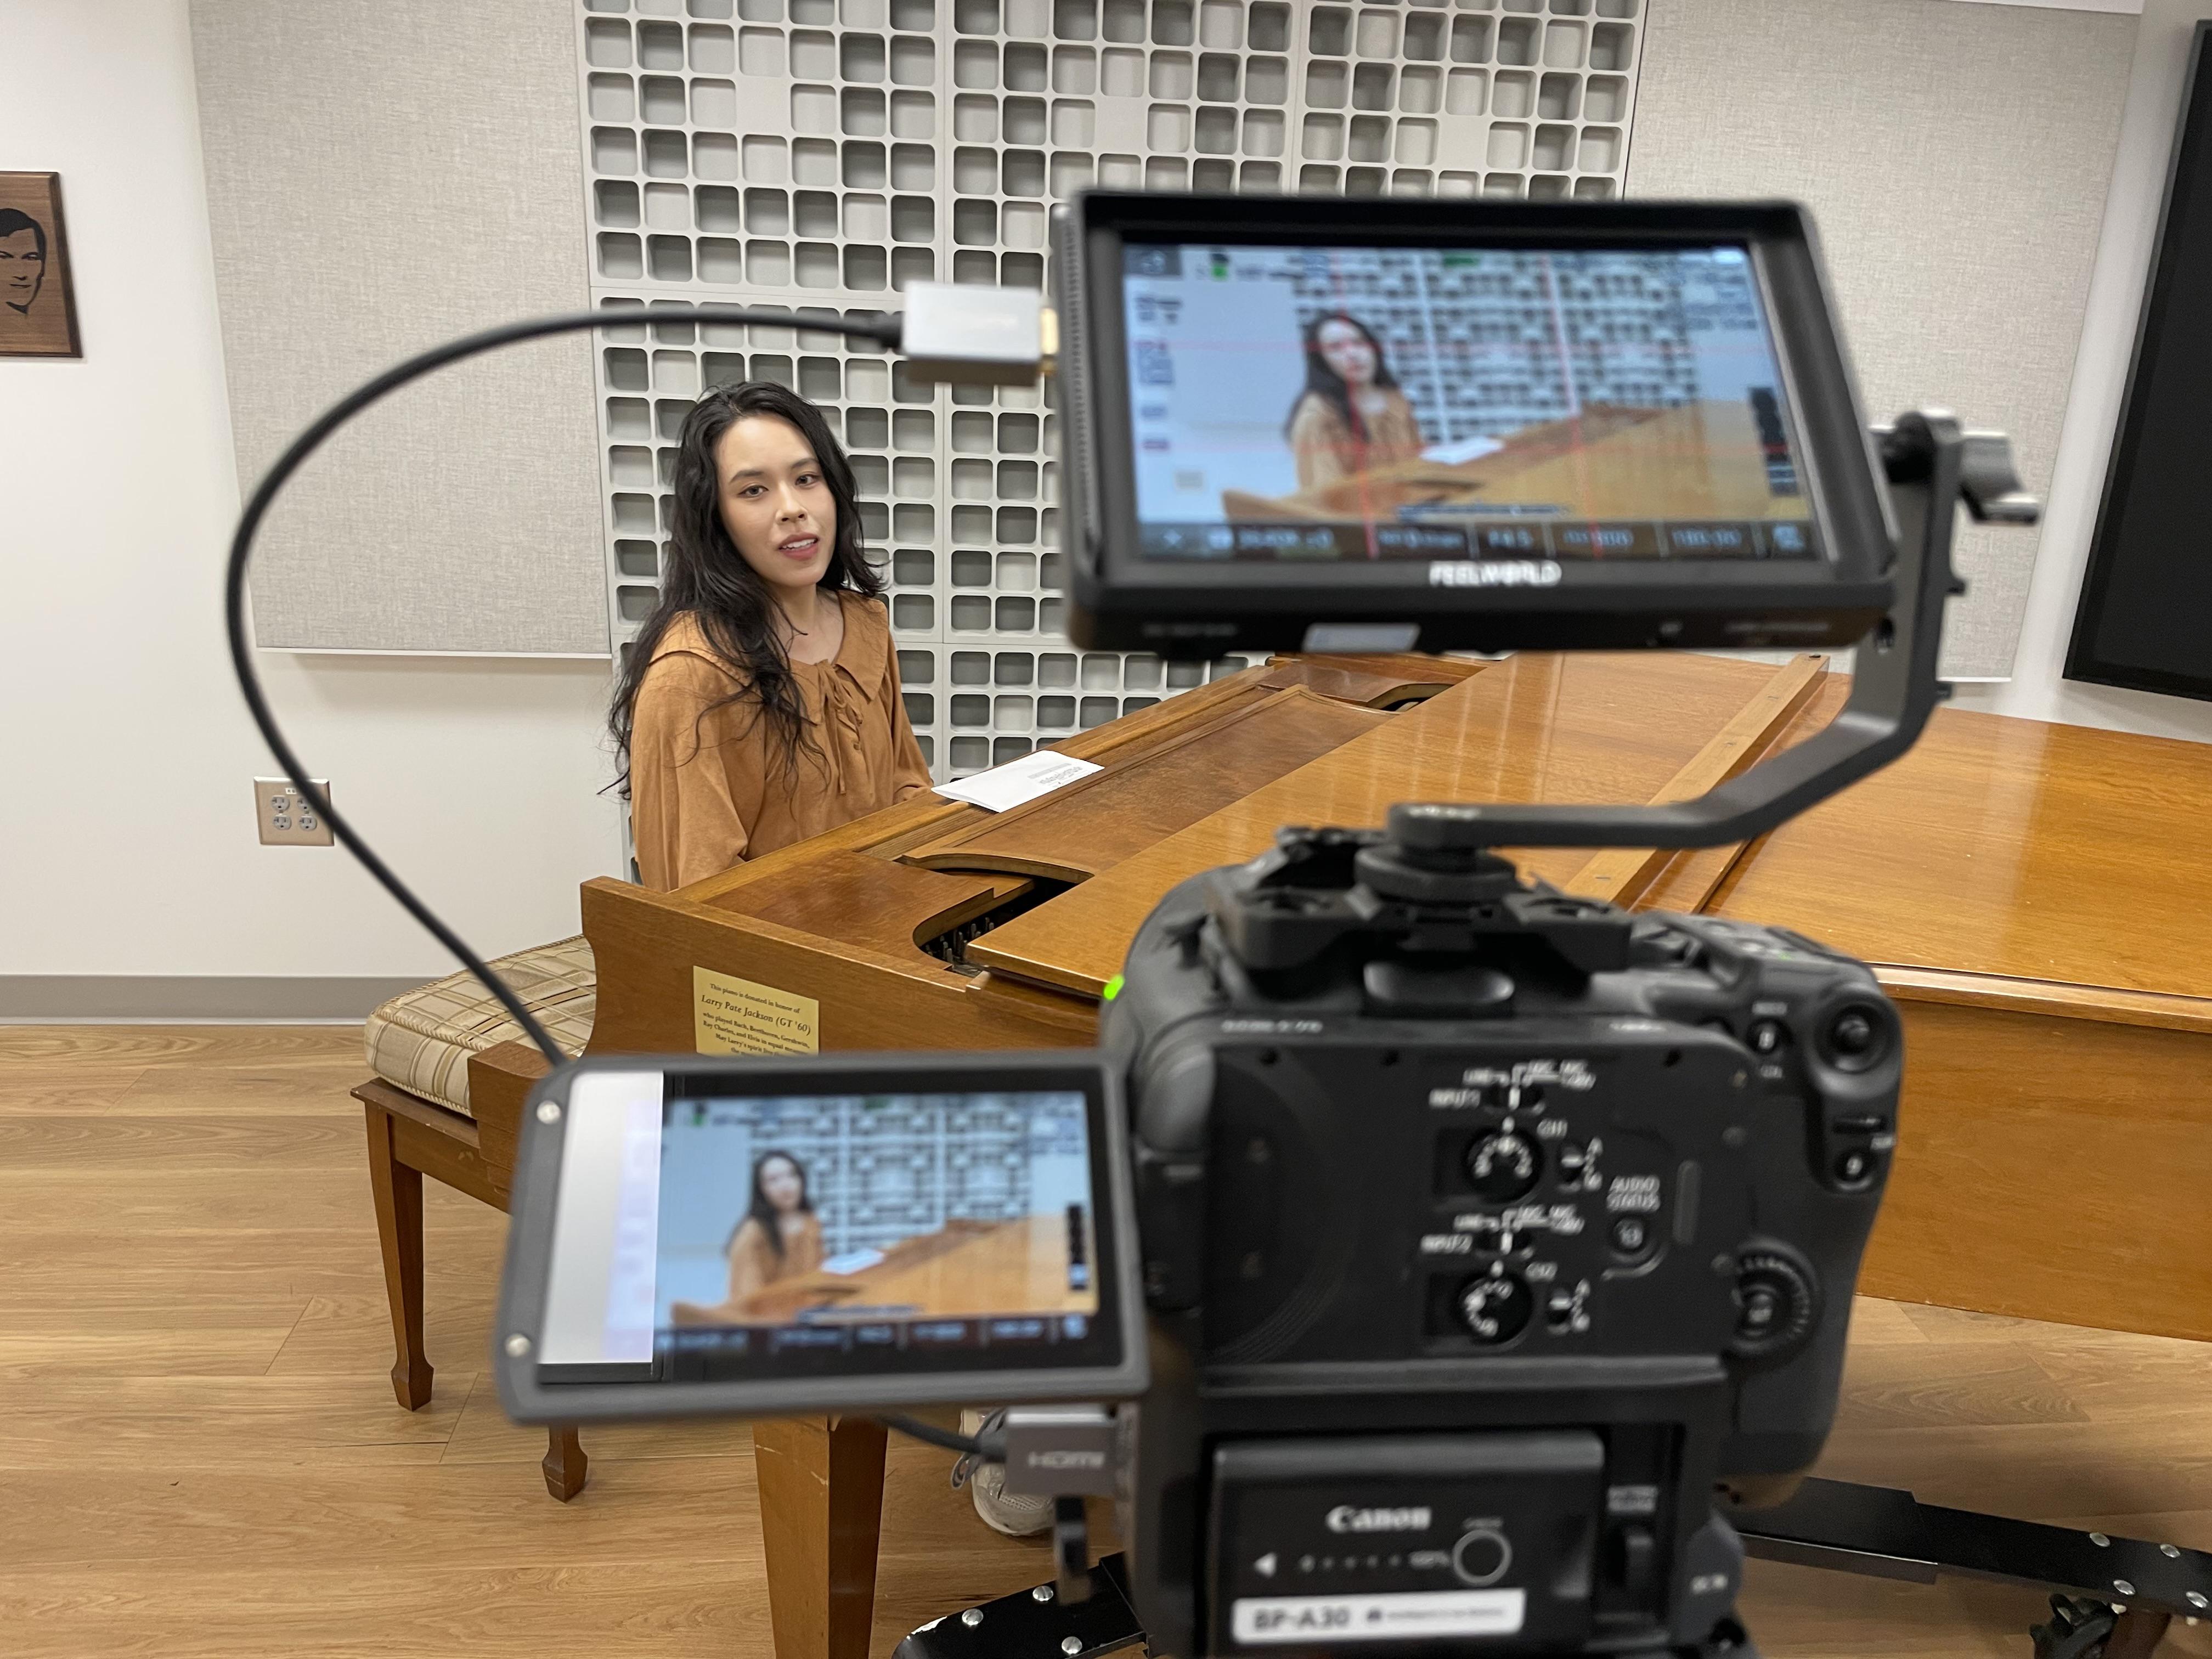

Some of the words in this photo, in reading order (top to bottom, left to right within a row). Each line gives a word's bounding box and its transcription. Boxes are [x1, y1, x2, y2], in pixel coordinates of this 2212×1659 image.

[701, 995, 723, 1009] Larry
[725, 1001, 742, 1013] Pate
[743, 1007, 773, 1023] Jackson
[776, 1017, 793, 1028] (GT
[795, 1020, 811, 1036] '60)
[744, 994, 767, 1004] donated
[775, 1002, 793, 1011] honor
[703, 1020, 713, 1029] Ray
[714, 1024, 736, 1035] Charles,
[748, 1034, 760, 1042] Elvis
[715, 1015, 733, 1025] played
[734, 1020, 749, 1030] Bach,
[750, 1025, 780, 1040] Beethoven,
[781, 1035, 810, 1048] Gershwin,
[716, 1033, 726, 1042] May
[728, 1037, 747, 1047] Larry's
[1325, 1504, 1432, 1534] Canon
